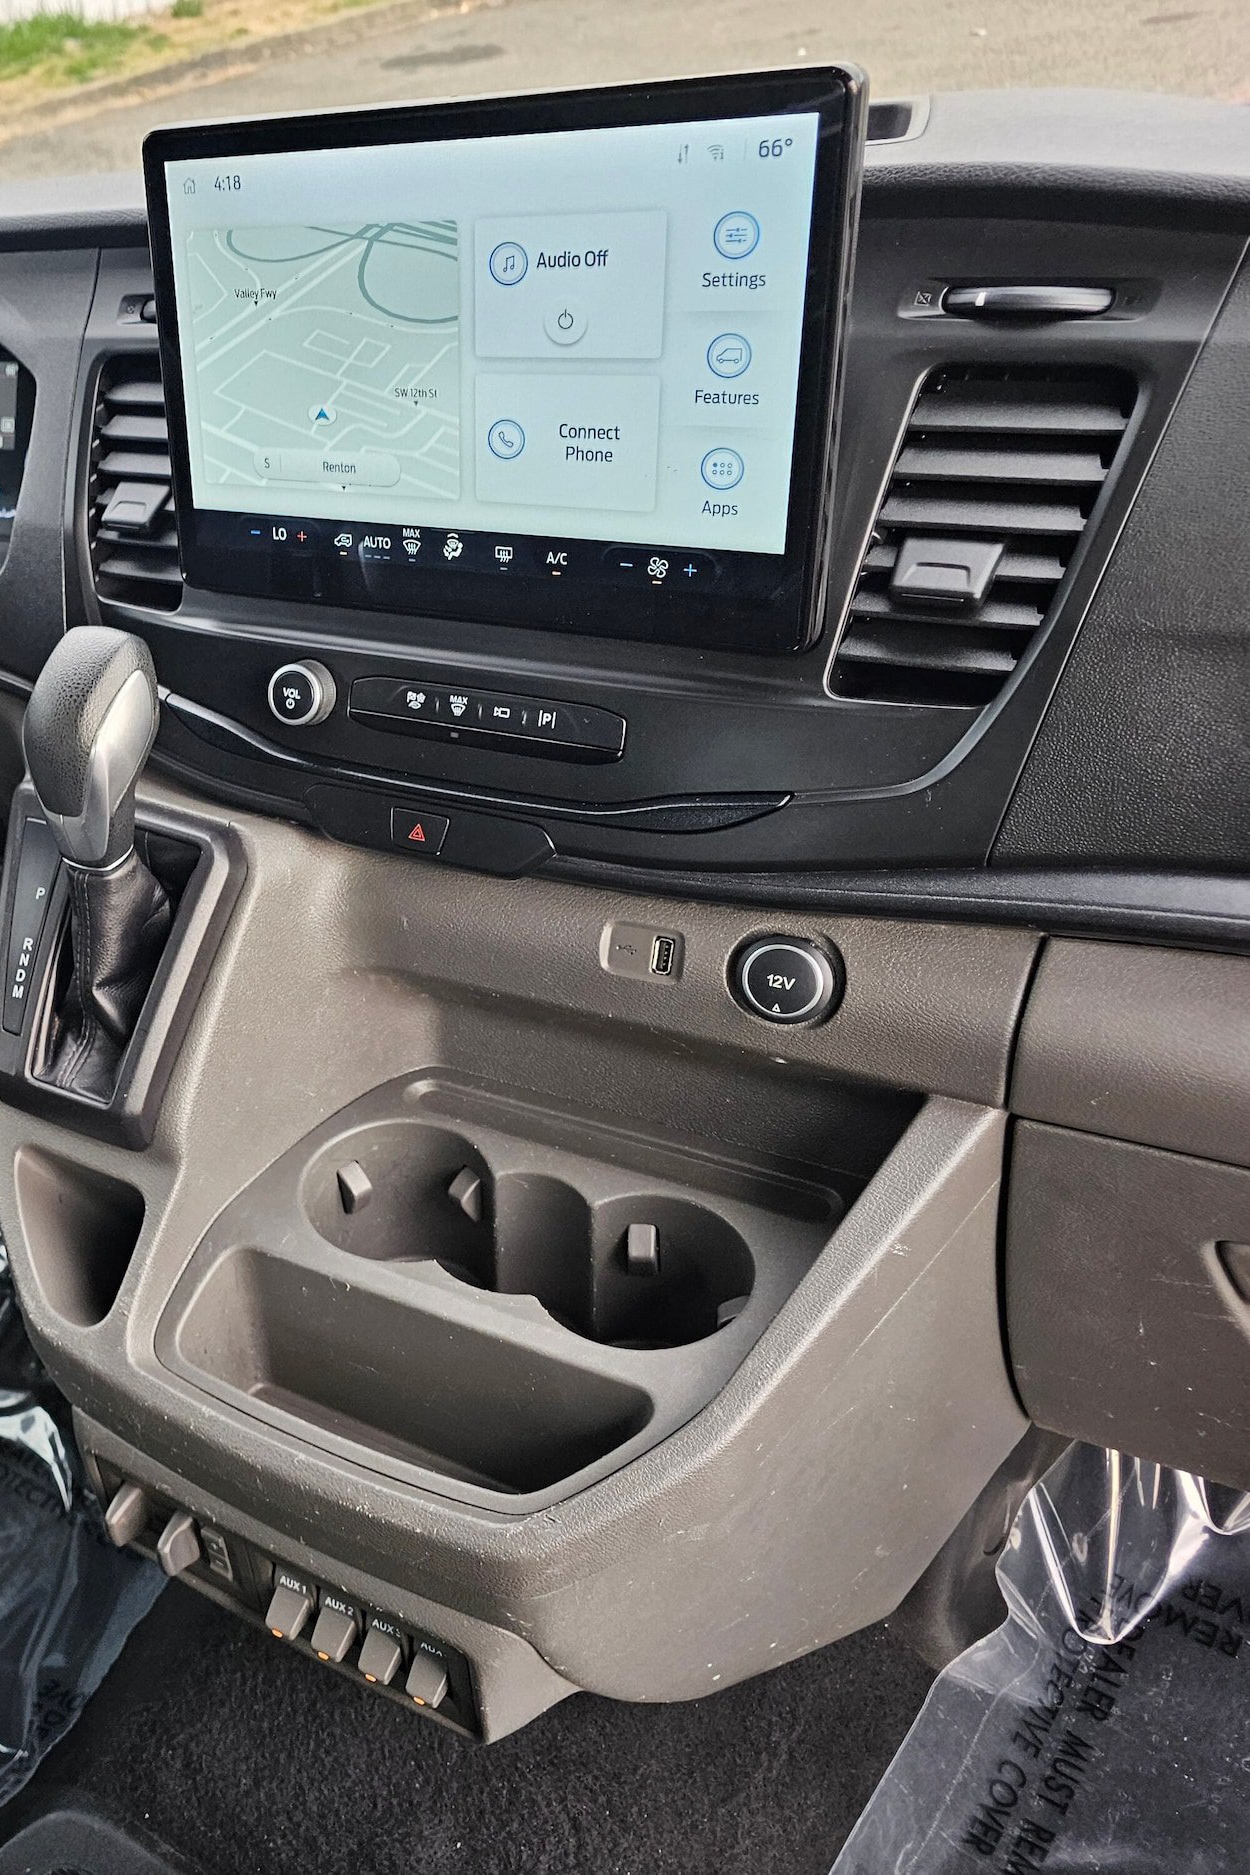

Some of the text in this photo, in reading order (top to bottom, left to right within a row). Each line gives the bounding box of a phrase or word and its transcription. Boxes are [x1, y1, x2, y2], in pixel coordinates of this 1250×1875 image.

[758, 138, 793, 158] 66°
[214, 175, 241, 191] 4:18
[536, 250, 609, 268] Audio Off
[702, 272, 766, 289] Settings
[234, 288, 277, 300] Valley Fwy
[394, 387, 437, 399] SW 12th St
[695, 390, 760, 405] Features
[559, 424, 620, 440] Connect
[566, 446, 613, 462] Phone
[322, 461, 357, 474] Renton
[702, 501, 738, 517] Apps
[273, 527, 287, 541] LO
[403, 528, 421, 538] MAX
[363, 535, 391, 550] AUTO
[546, 552, 568, 565] A/C
[283, 687, 301, 700] VOL
[450, 695, 468, 705] MAX
[12, 887, 46, 999] P R N D M
[766, 974, 796, 991] 12V
[279, 1575, 307, 1594] AUX 1
[324, 1596, 354, 1616] AUX 2
[372, 1618, 394, 1635] AUX
[1038, 1730, 1092, 1816] MUST
[959, 1759, 1028, 1857] COVER
